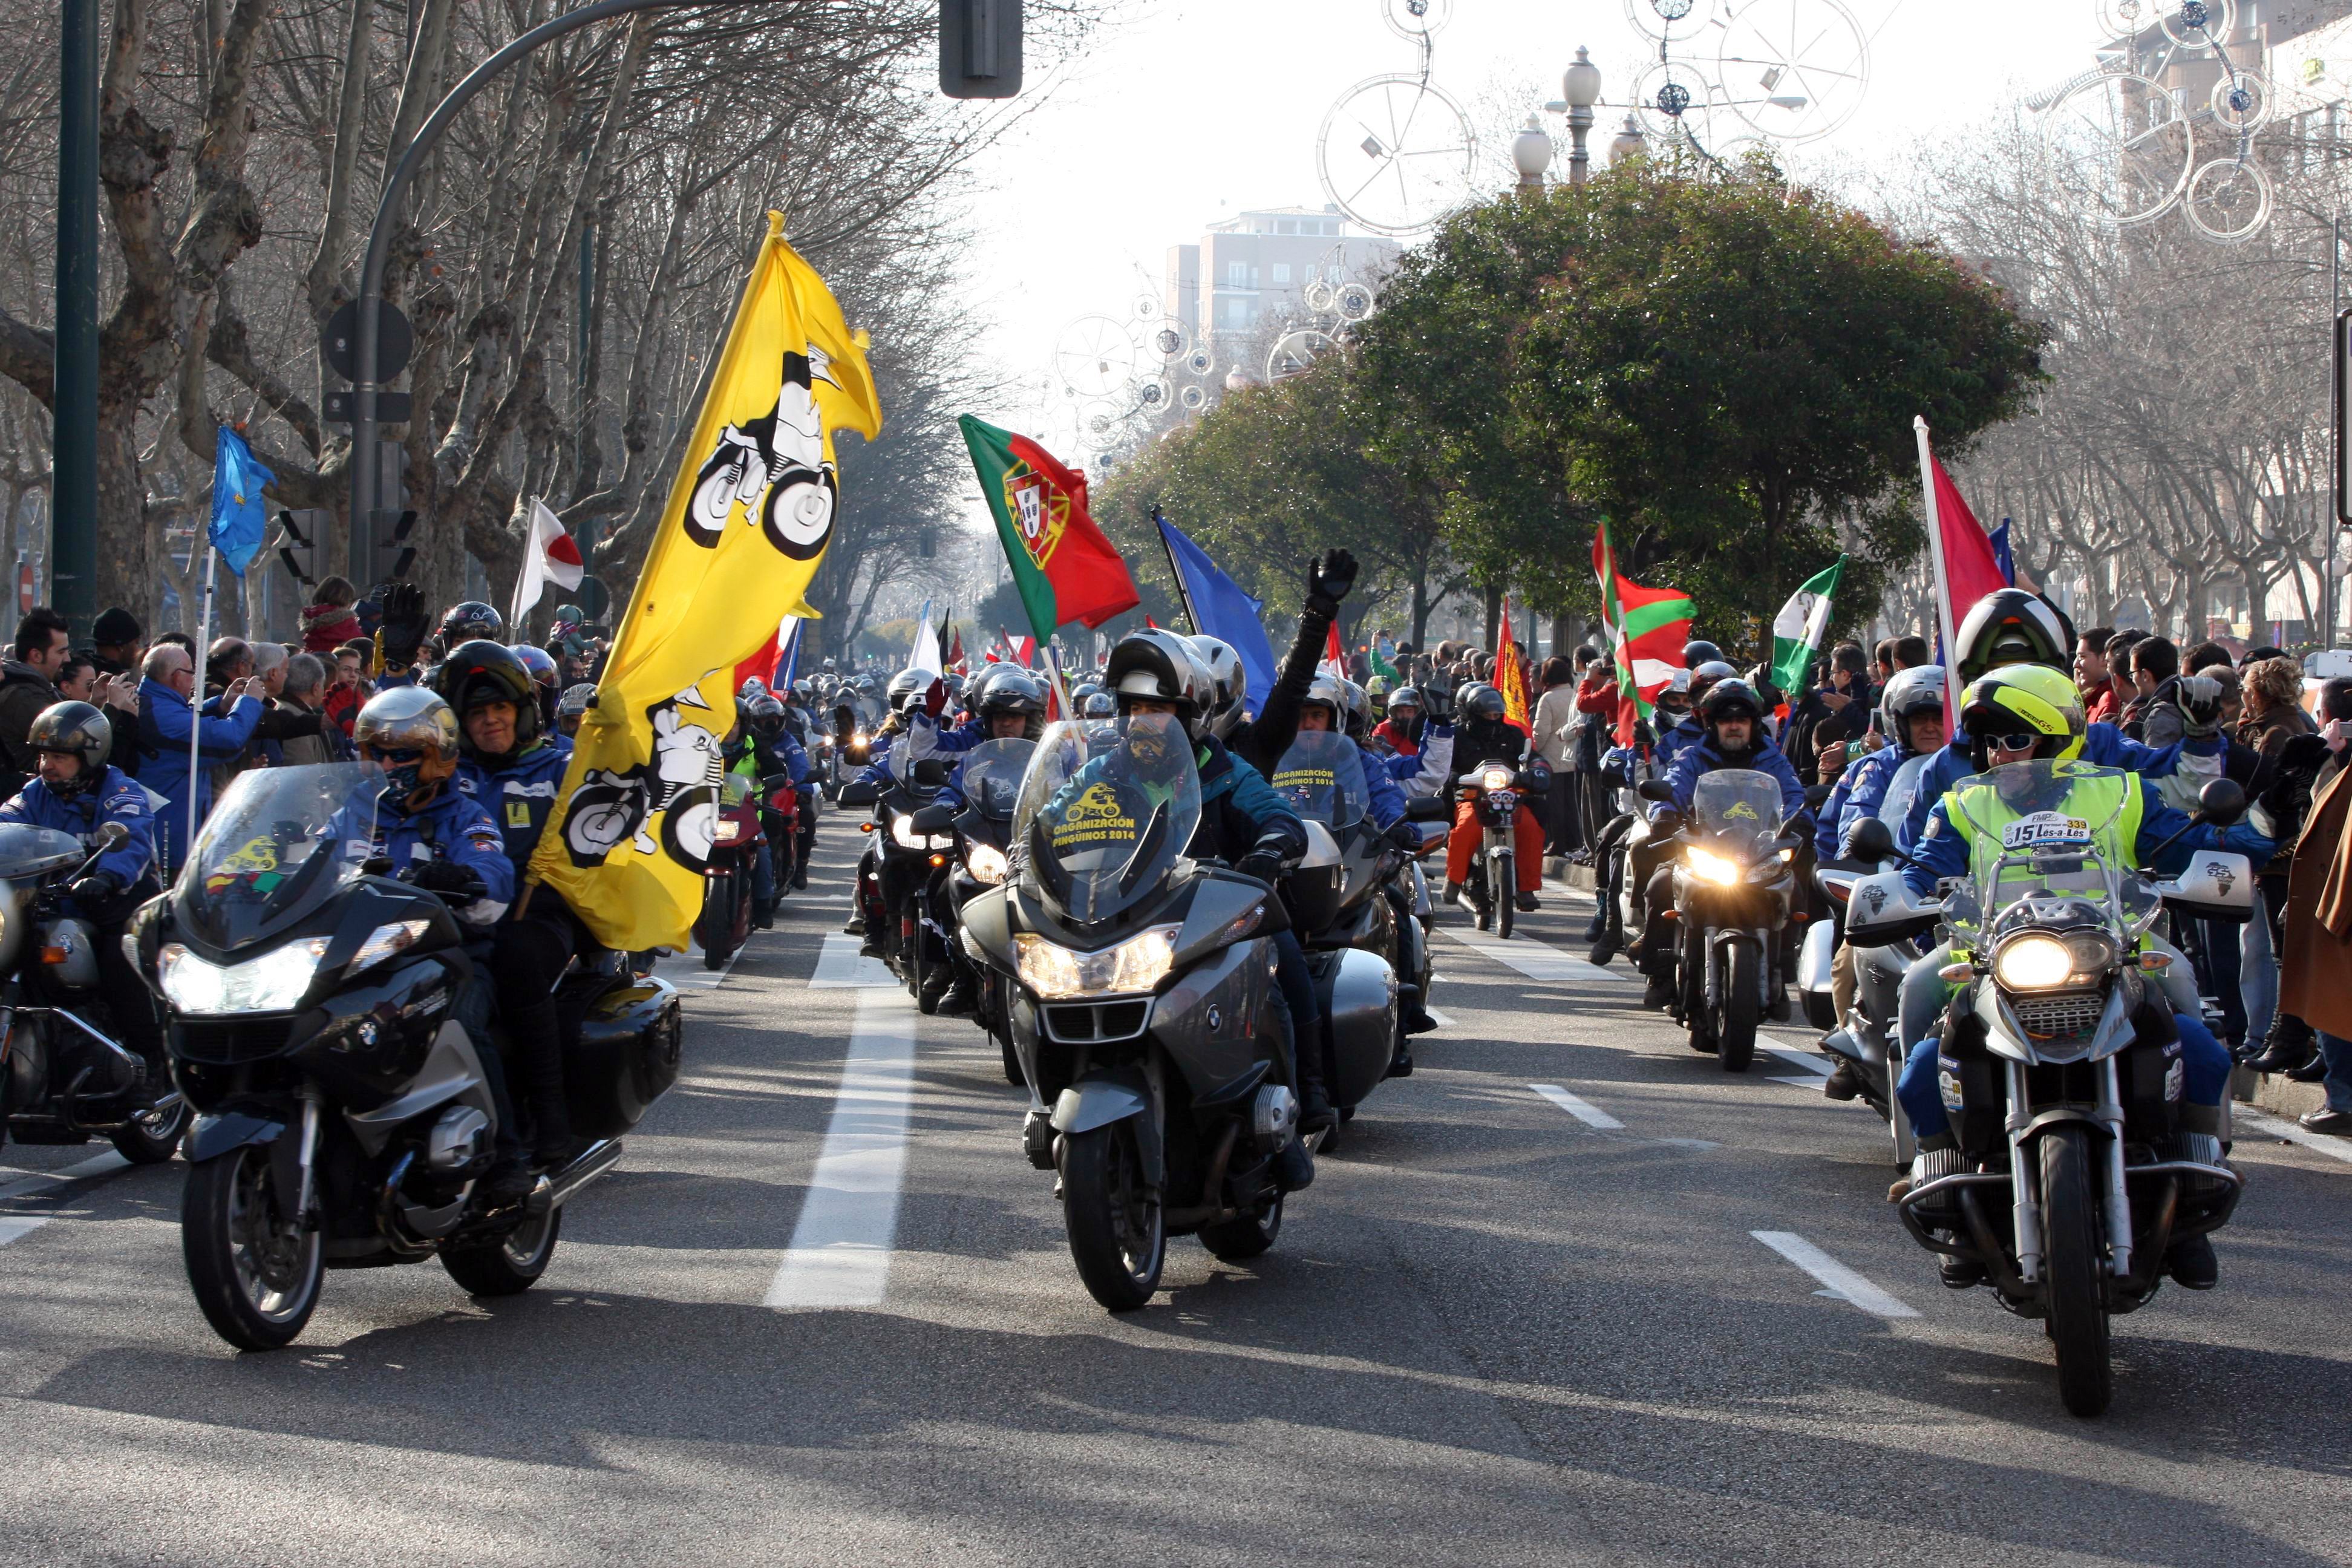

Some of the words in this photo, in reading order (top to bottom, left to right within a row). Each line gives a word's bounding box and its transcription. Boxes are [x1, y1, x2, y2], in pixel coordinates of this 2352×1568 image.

[1272, 768, 1333, 780] ORGANIZACIÓN
[1272, 777, 1313, 788] PINGÜINOS
[1053, 815, 1135, 835] ORGANIZACIÓN
[2068, 820, 2087, 829] 339
[1053, 831, 1106, 848] PINGÜINOS
[1109, 830, 1135, 840] 2014
